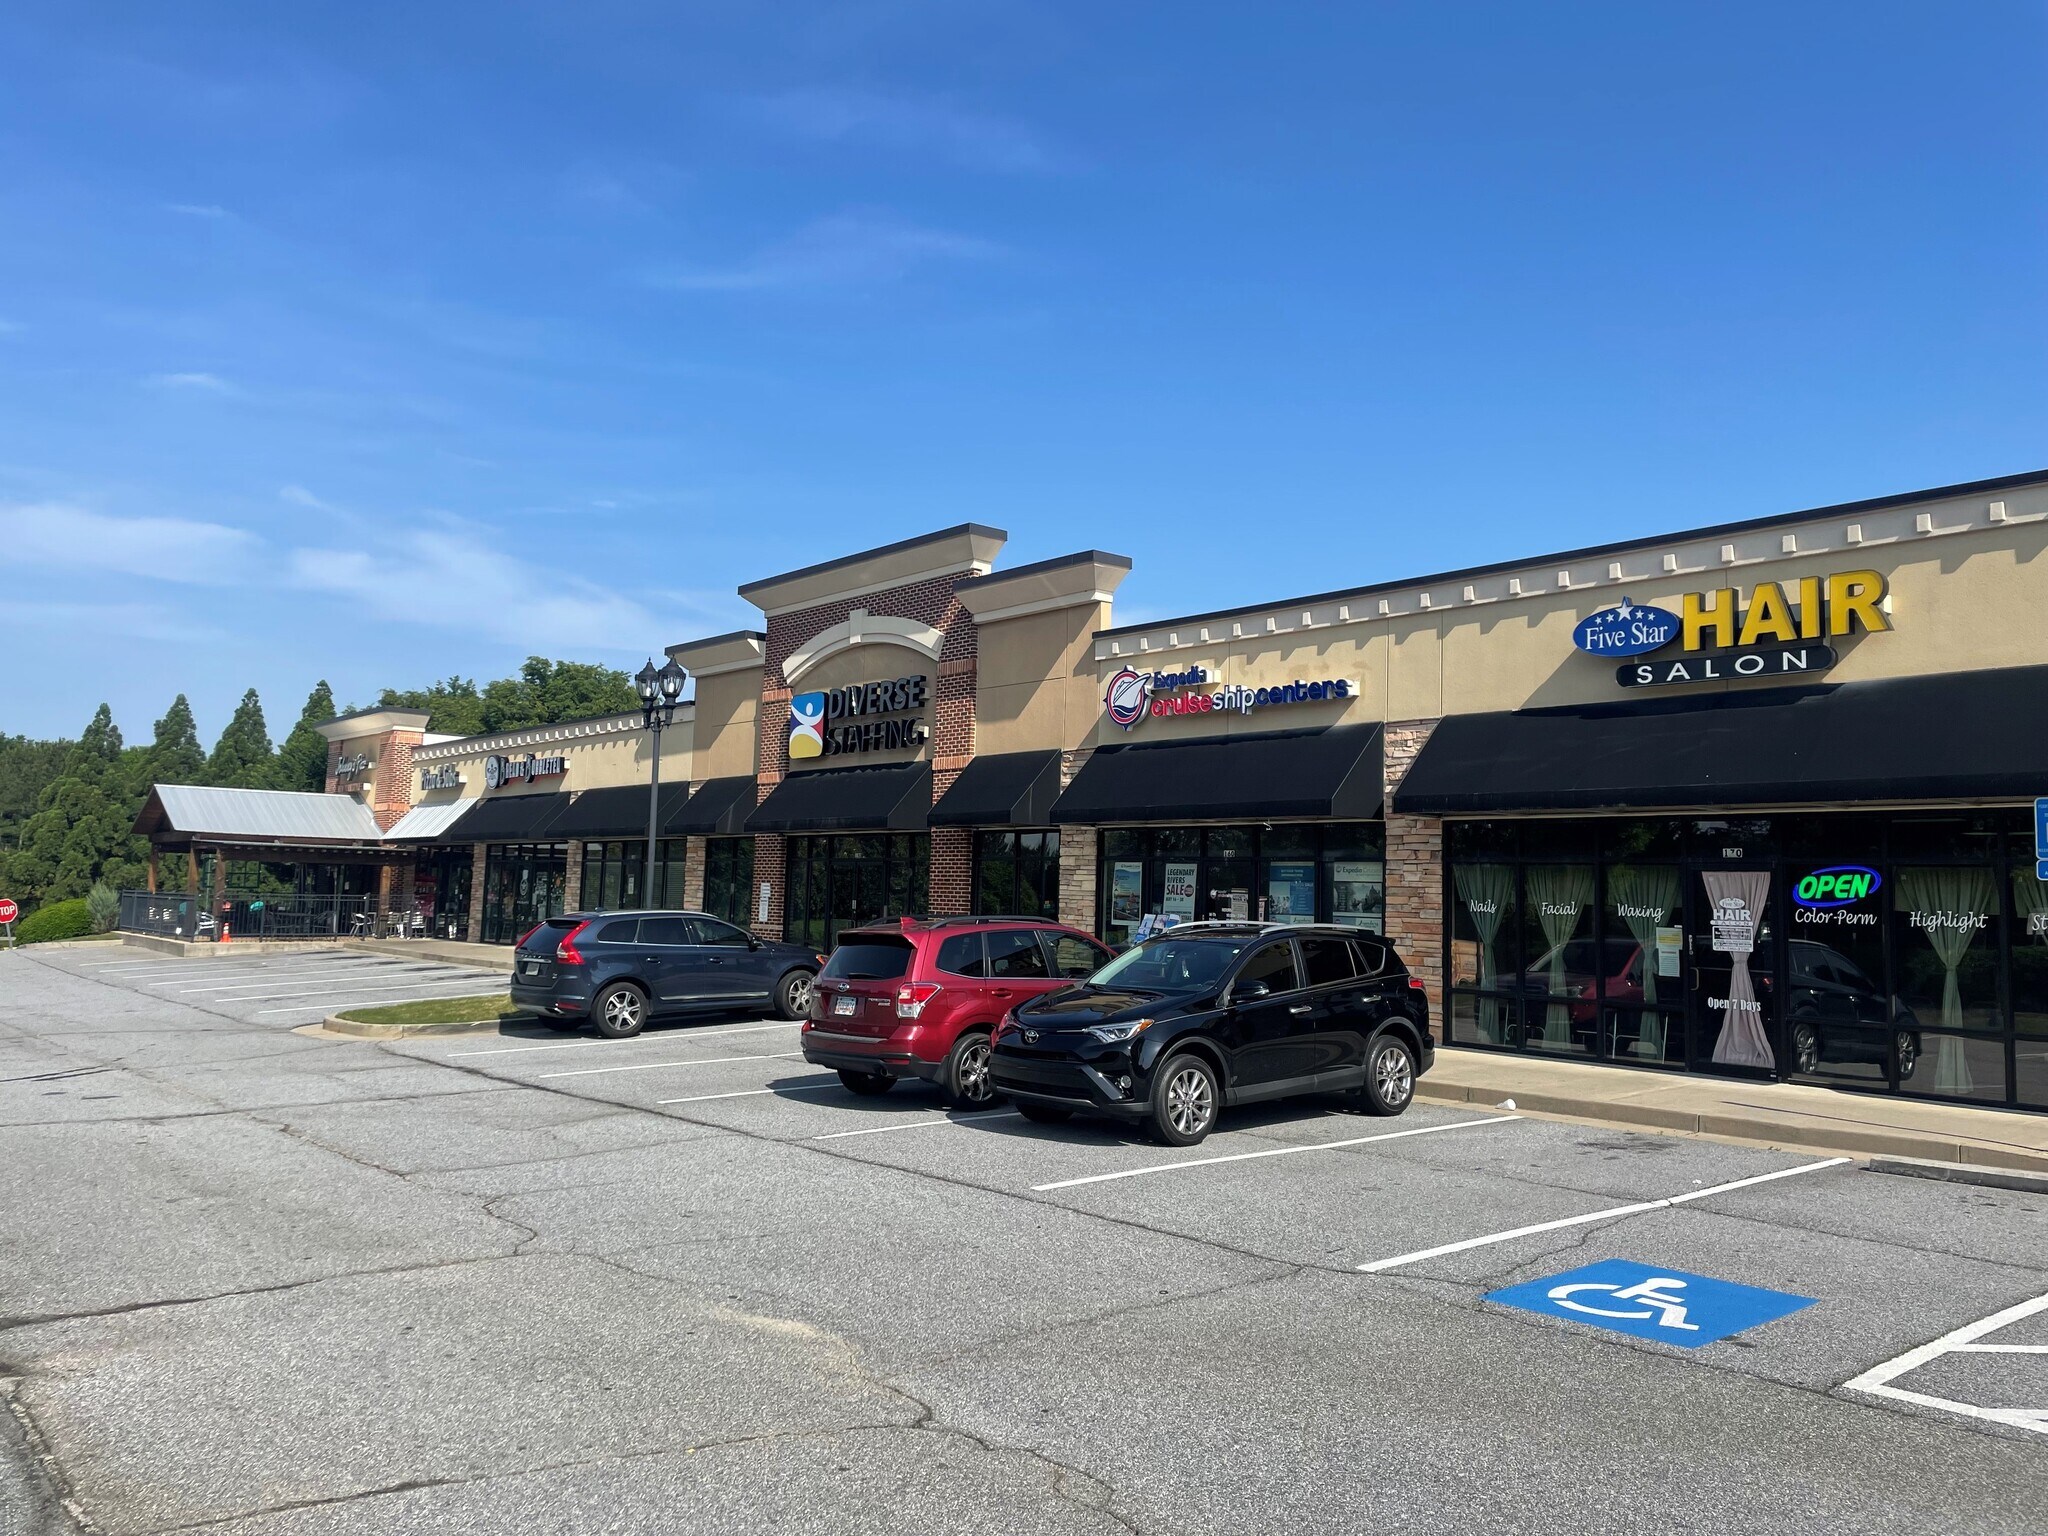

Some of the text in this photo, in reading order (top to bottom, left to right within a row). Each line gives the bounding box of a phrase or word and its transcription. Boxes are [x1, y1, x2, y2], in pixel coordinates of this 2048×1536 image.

[1683, 569, 1892, 651] HAIR
[1585, 622, 1669, 650] Five Star
[1636, 650, 1807, 684] SALON
[1153, 665, 1207, 691] Expedia
[828, 675, 925, 719] DIVERSE
[1151, 678, 1351, 716] cruiseshipcenters
[825, 717, 926, 756] STAFFING
[1167, 868, 1195, 876] LEGENDARY
[1167, 876, 1186, 884] RIVERS
[1166, 884, 1184, 896] SALE
[1799, 874, 1871, 899] OPEN
[0, 905, 15, 916] TOP
[1470, 899, 1497, 914] Nails
[1541, 901, 1578, 916] Facial
[1617, 903, 1664, 923] Waxing
[1713, 908, 1752, 921] HAIR
[1795, 908, 1878, 925] Color-Perm
[1910, 910, 1989, 934] Highlight
[1707, 997, 1761, 1013] Open 7 Days
